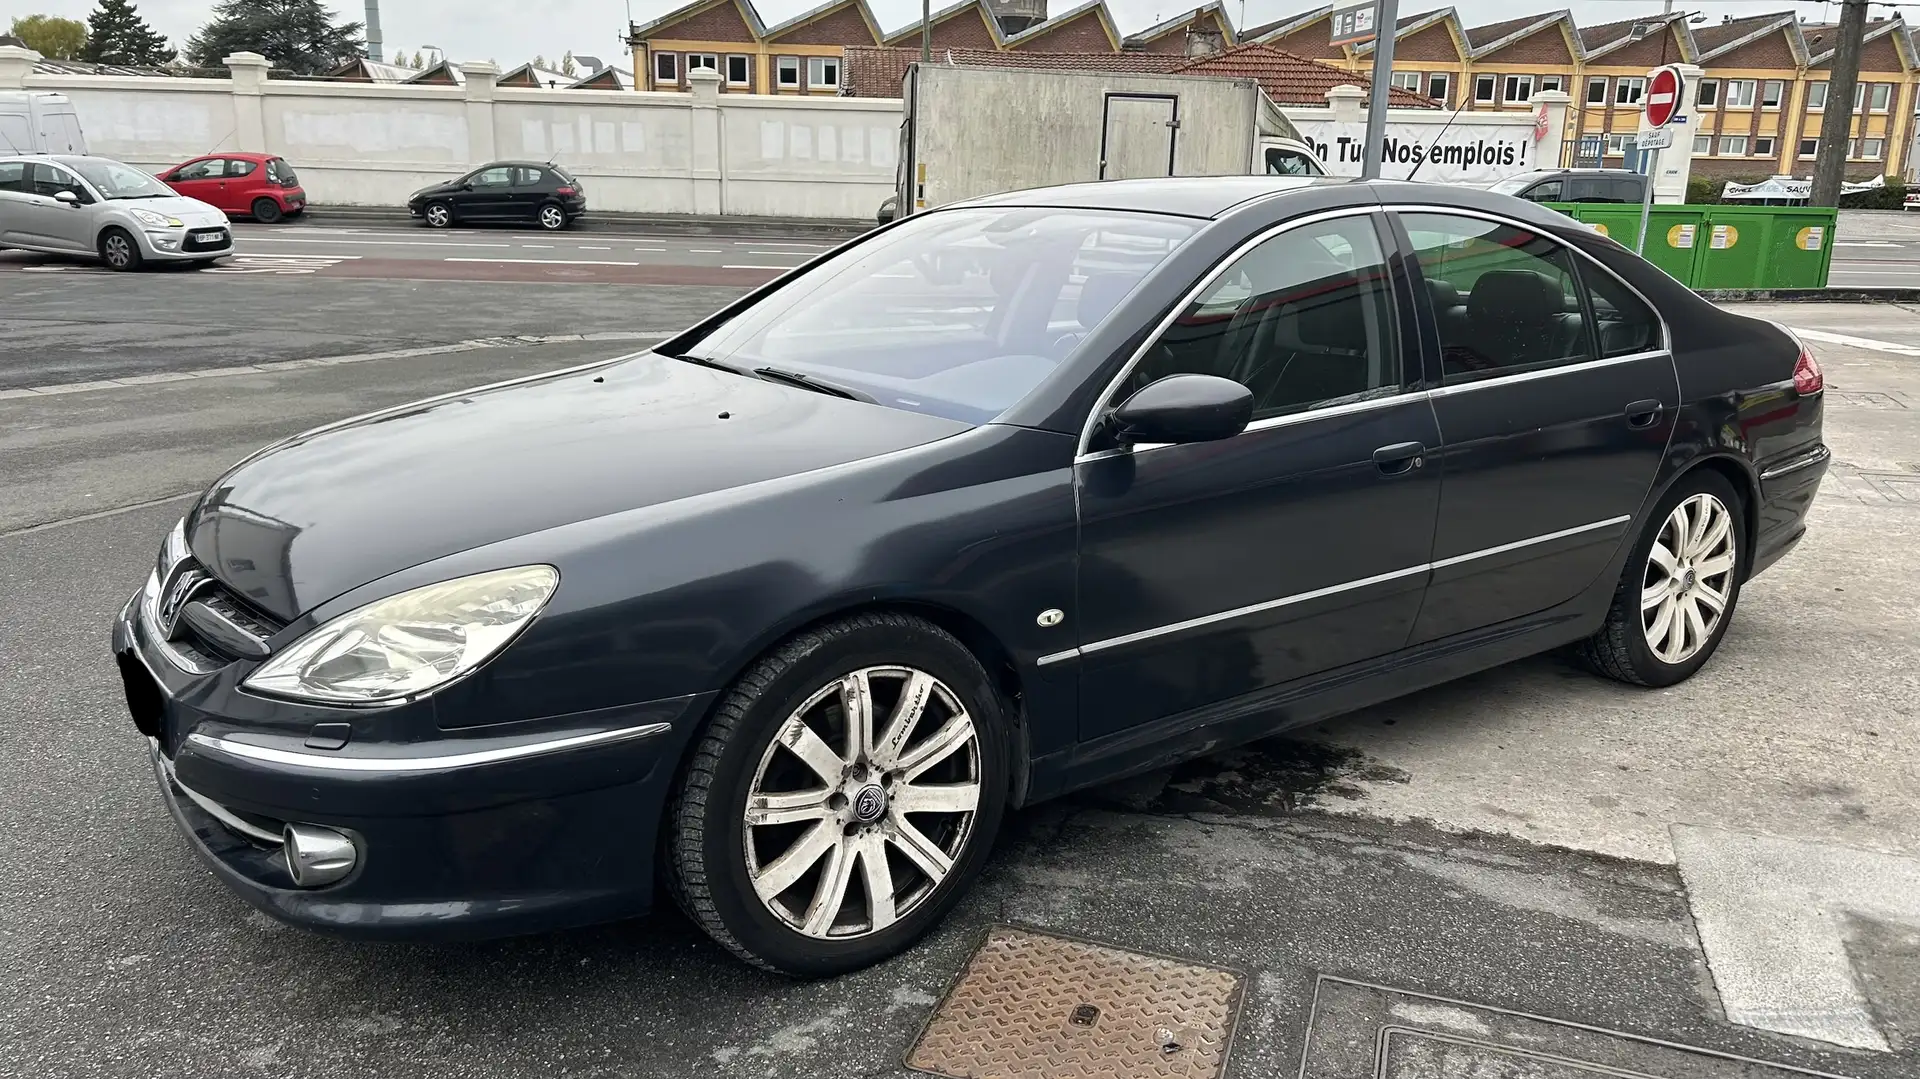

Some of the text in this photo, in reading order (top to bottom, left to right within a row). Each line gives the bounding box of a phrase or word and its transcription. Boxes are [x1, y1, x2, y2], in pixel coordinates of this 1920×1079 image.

[1337, 137, 1366, 163] Tu
[1381, 137, 1423, 164] Nos
[1430, 140, 1514, 170] emplois
[1520, 140, 1527, 166] !
[1786, 185, 1811, 193] SAUV
